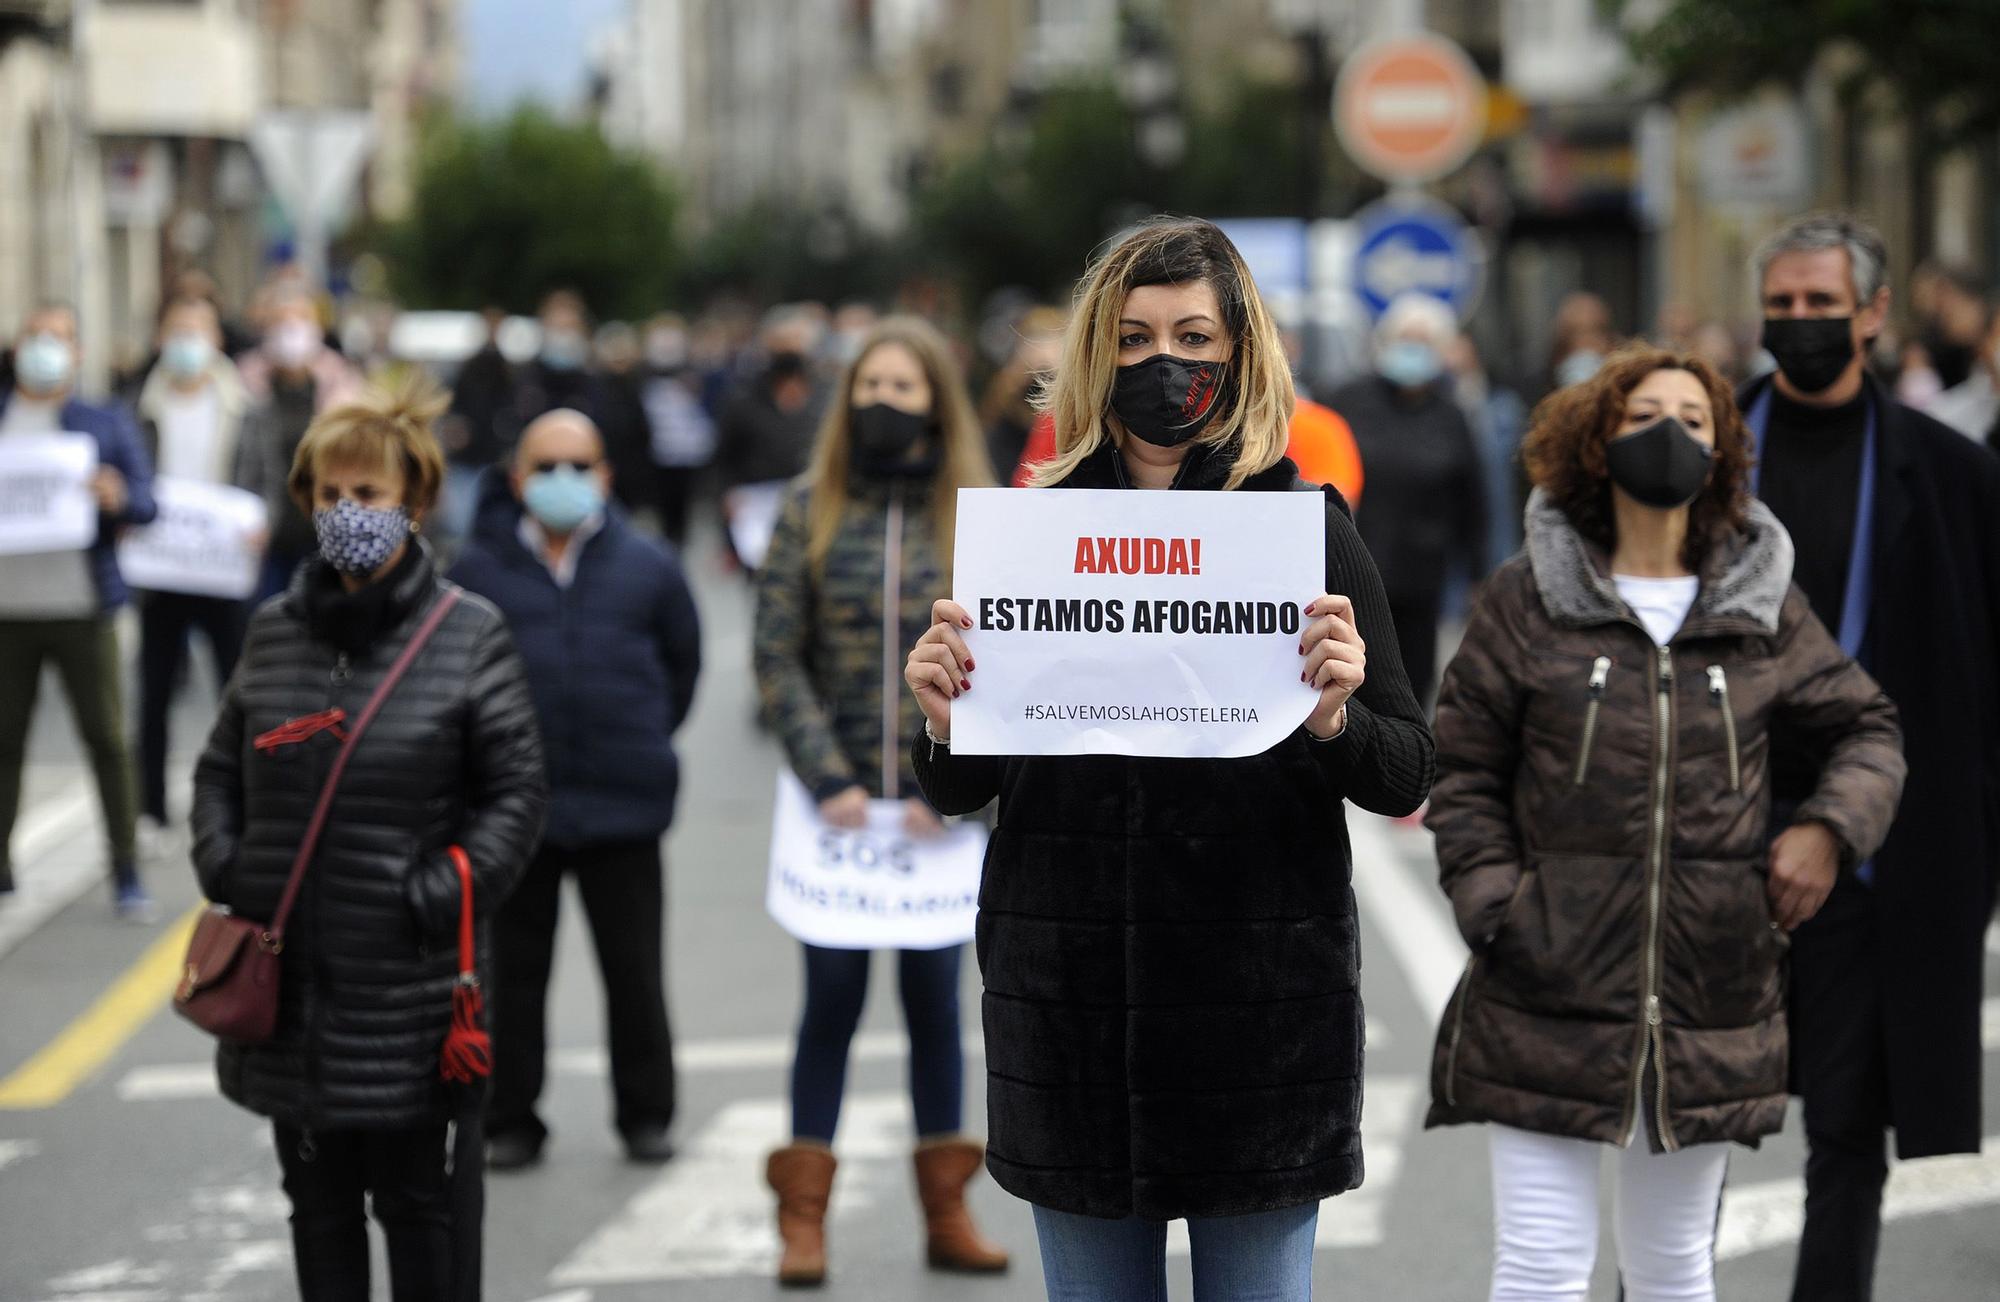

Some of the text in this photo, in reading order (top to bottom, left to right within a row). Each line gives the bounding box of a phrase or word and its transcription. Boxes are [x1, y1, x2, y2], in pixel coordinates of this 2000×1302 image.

[1073, 537, 1201, 575] AXUDA!
[979, 598, 1300, 634] ESTAMOS AFOGANDO
[1024, 704, 1259, 723] #SALVEMOSLAHOSTELERIA
[816, 828, 915, 877] SOS
